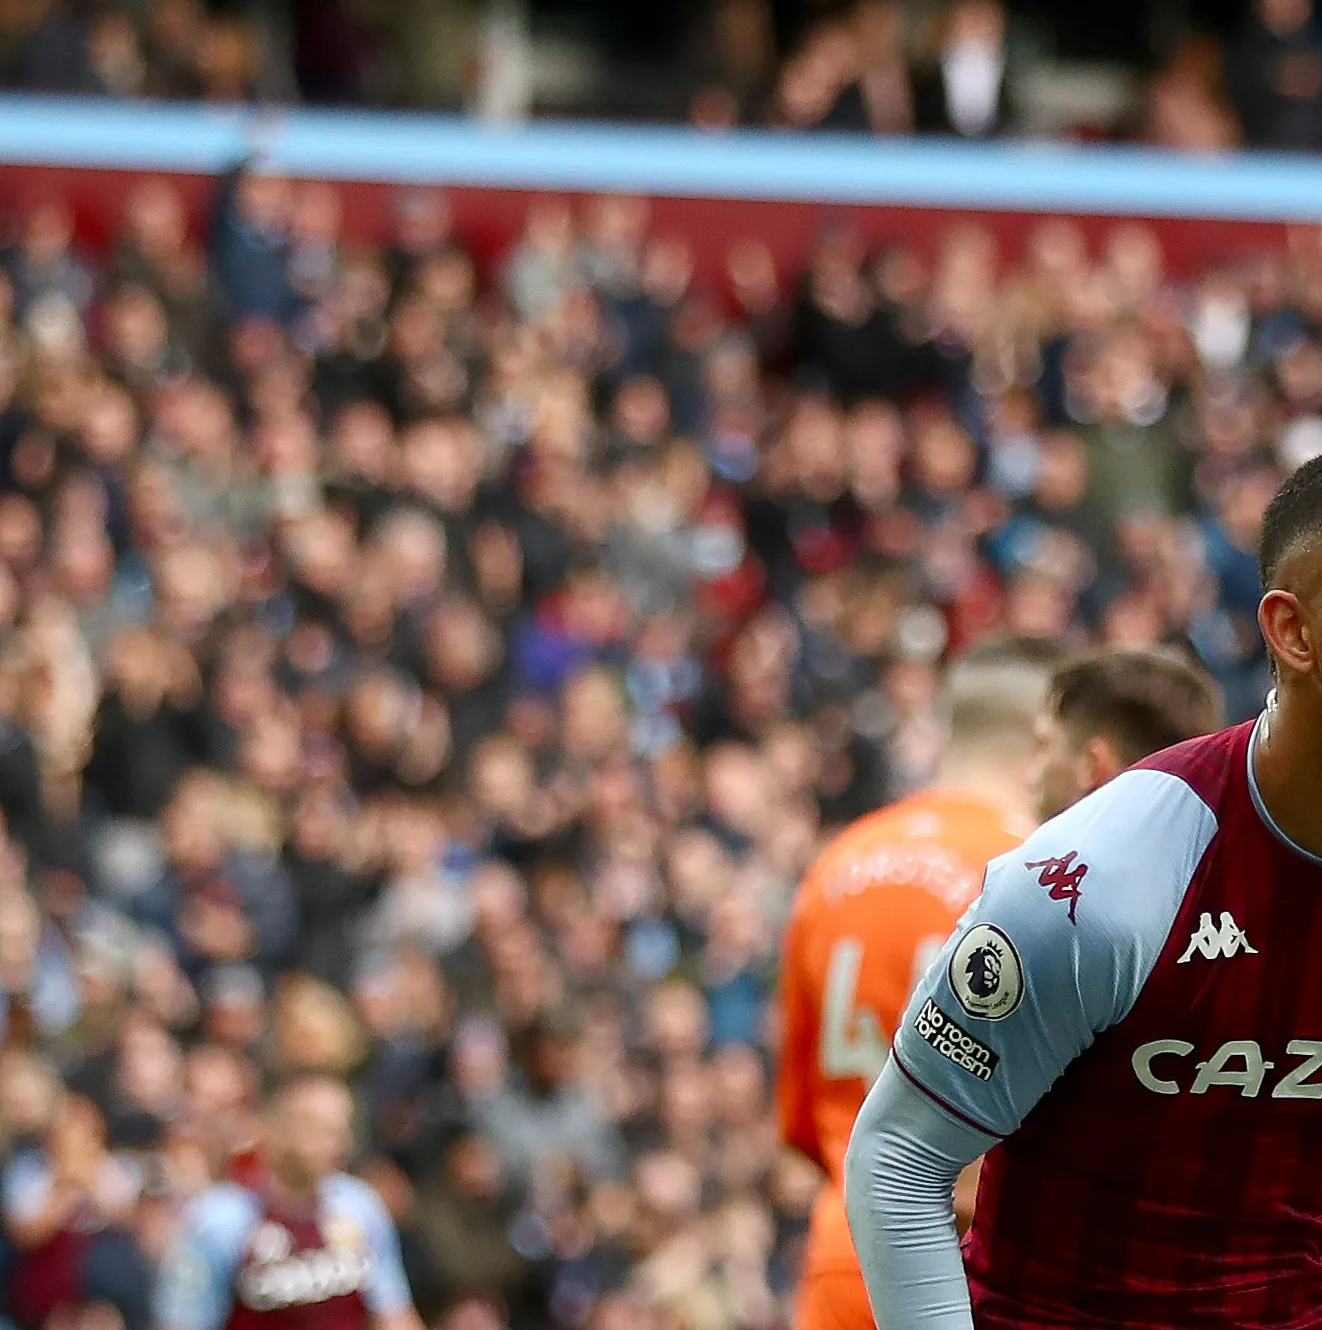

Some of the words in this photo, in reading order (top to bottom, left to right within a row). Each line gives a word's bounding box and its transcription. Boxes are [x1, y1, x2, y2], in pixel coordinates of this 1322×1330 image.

[913, 1013, 937, 1041] for
[932, 1034, 993, 1082] racism
[922, 999, 944, 1028] No
[942, 1022, 991, 1064] room
